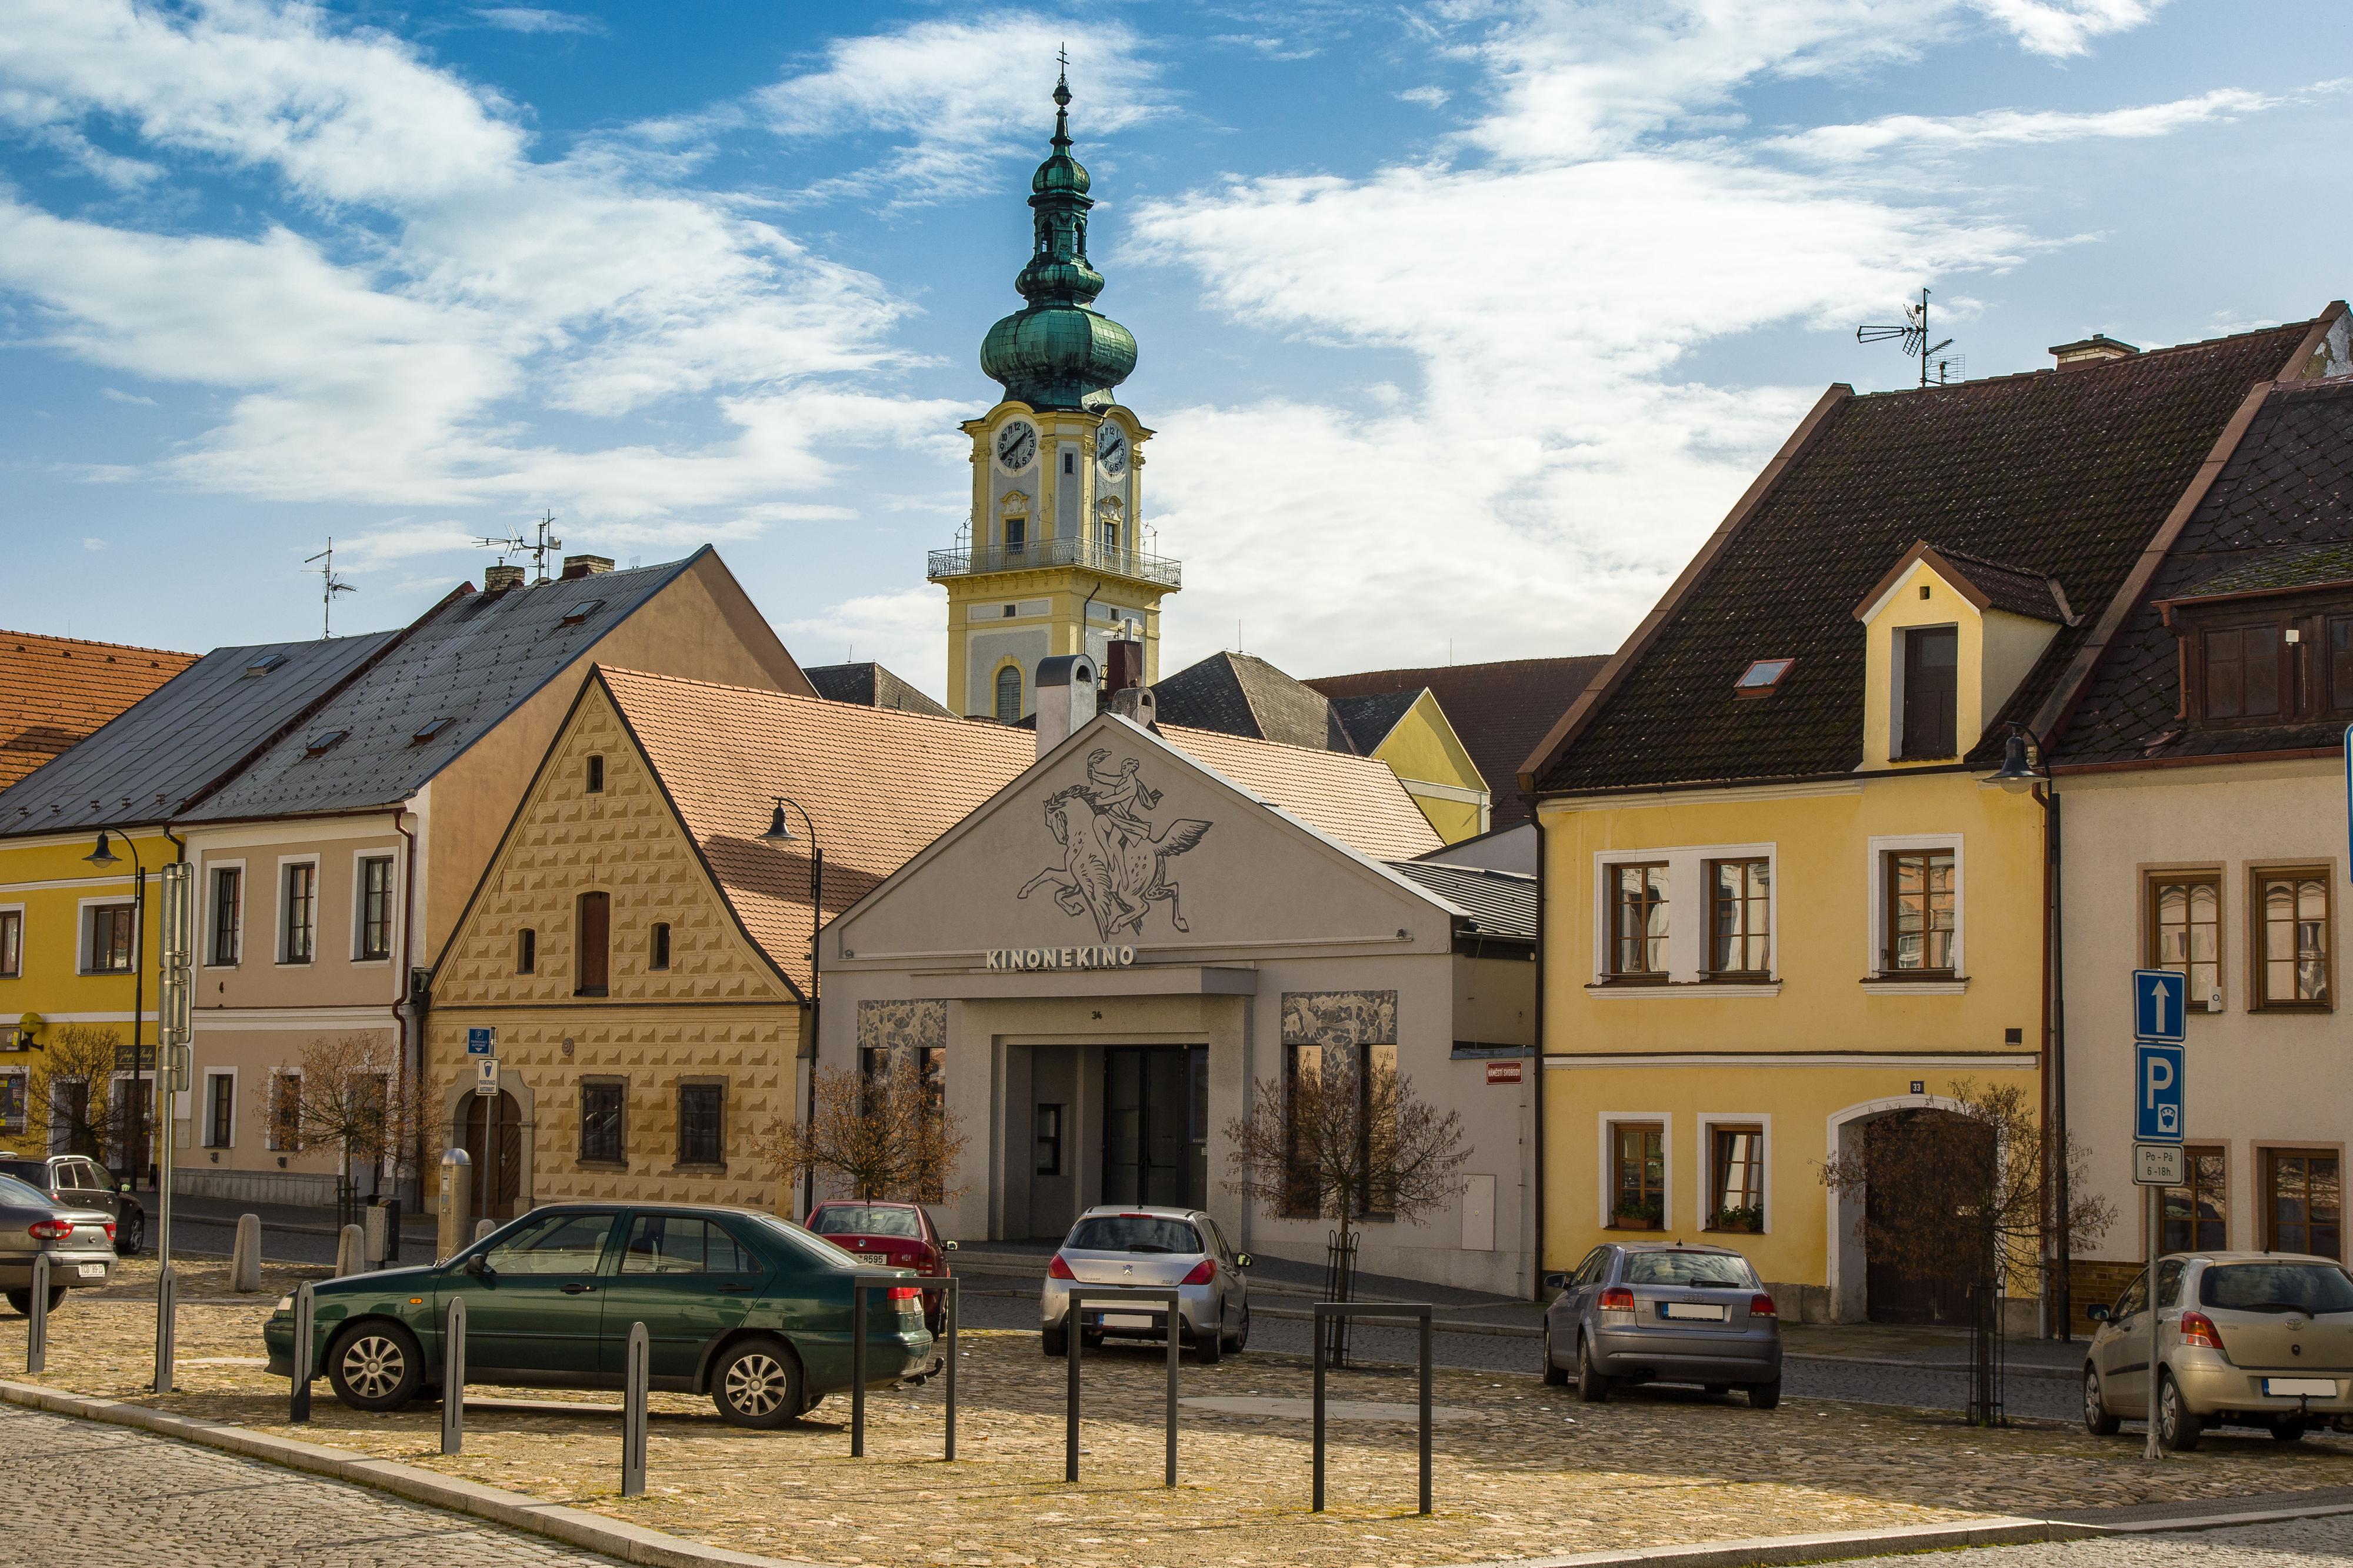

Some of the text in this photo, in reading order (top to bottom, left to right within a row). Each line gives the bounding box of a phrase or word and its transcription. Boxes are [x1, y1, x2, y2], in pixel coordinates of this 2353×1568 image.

[1008, 426, 1012, 434] 11
[1014, 422, 1021, 431] 12
[1105, 427, 1108, 435] 11
[1109, 426, 1114, 435] 12
[1002, 433, 1007, 442] 10
[1028, 430, 1033, 438] 2
[1100, 432, 1105, 441] 10
[999, 443, 1005, 451] 9
[1029, 439, 1035, 448] 3
[1098, 442, 1102, 450] 9
[1120, 448, 1124, 456] 3
[1008, 458, 1012, 467] 7
[1015, 459, 1019, 468] 6
[1114, 463, 1119, 471] 5
[1109, 463, 1113, 472] 6
[986, 946, 1136, 969] KINONEKINO
[1091, 1011, 1102, 1020] 34
[1488, 1067, 1503, 1077] NÁMĚSTÍ
[2147, 1056, 2174, 1109] P
[1913, 1083, 1921, 1092] 33
[2146, 1152, 2155, 1161] Po
[2164, 1152, 2173, 1162] Pá
[864, 1255, 883, 1263] 8595
